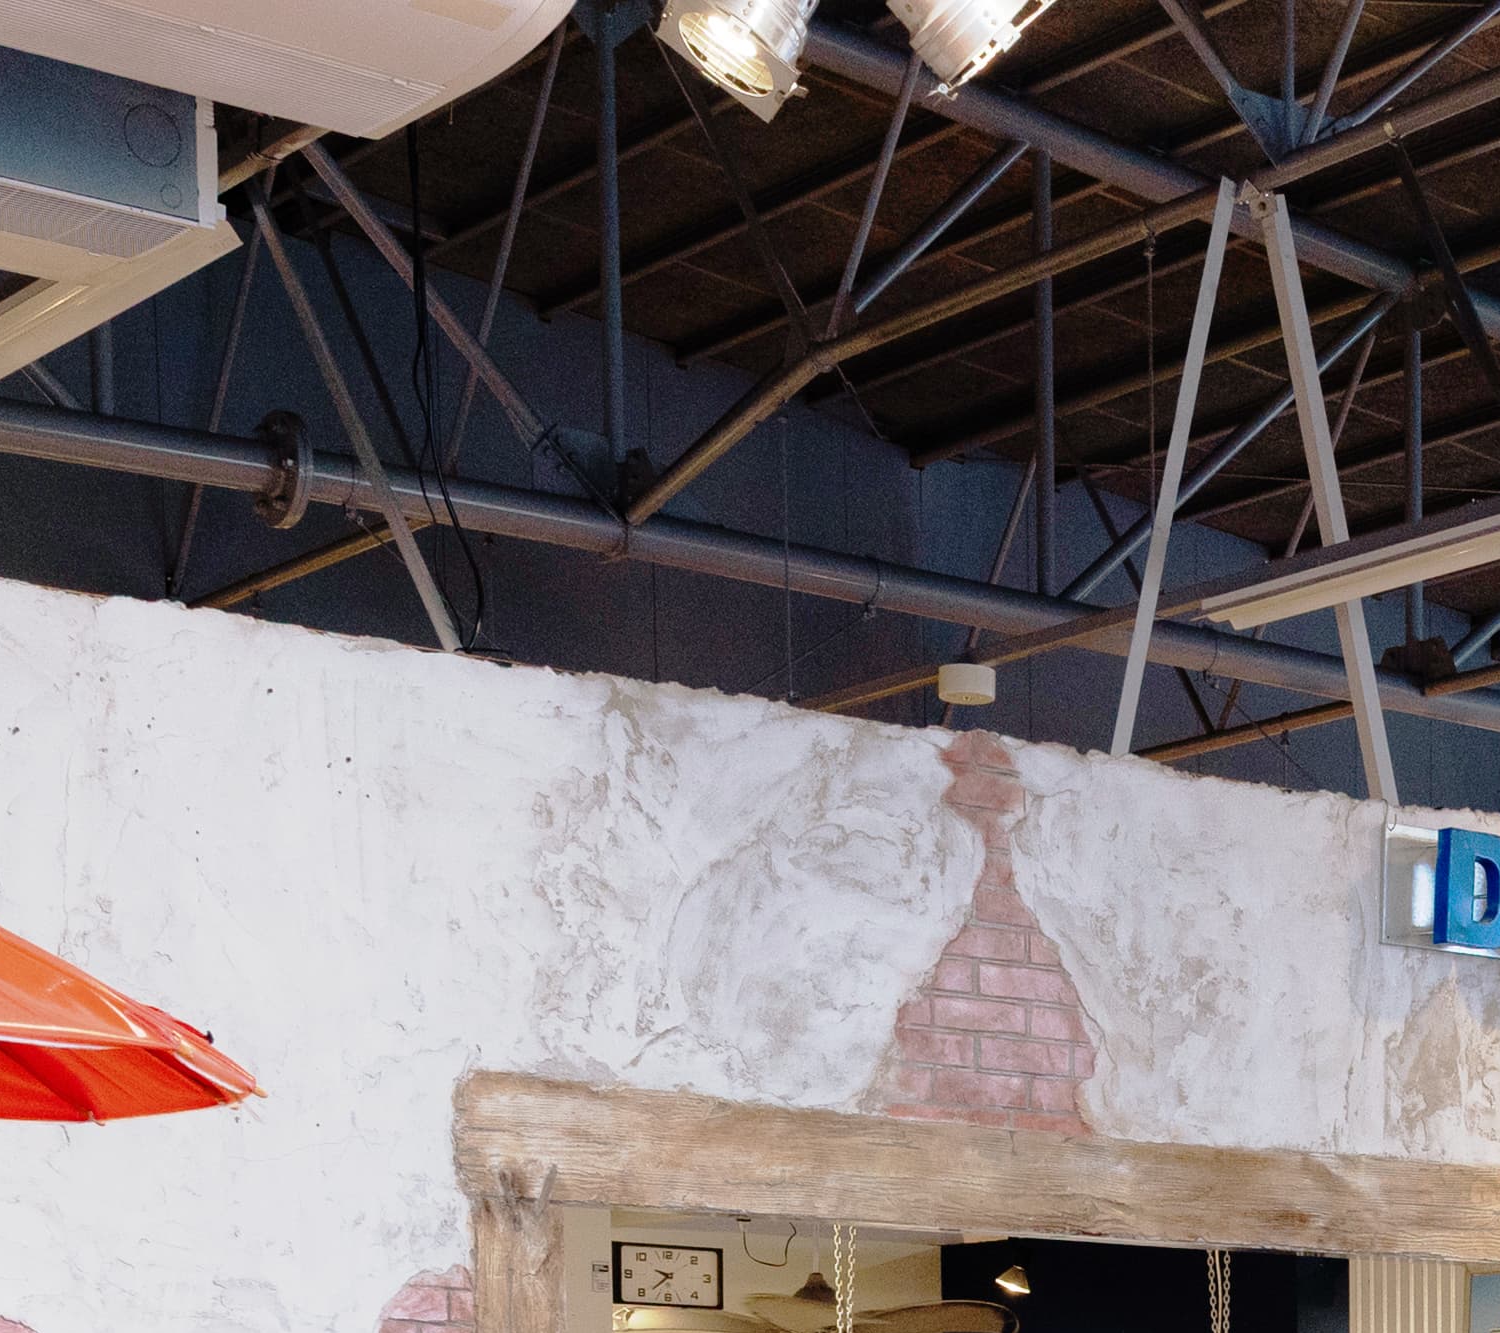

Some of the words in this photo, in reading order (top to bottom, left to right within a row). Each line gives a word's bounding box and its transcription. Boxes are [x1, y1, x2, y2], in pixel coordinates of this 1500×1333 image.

[636, 1252, 647, 1261] 10
[662, 1251, 673, 1260] 12
[690, 1256, 698, 1265] 2
[624, 1269, 633, 1279] 9
[703, 1274, 711, 1284] 3
[638, 1288, 646, 1297] 8
[690, 1291, 699, 1300] 4
[664, 1293, 672, 1302] 6
